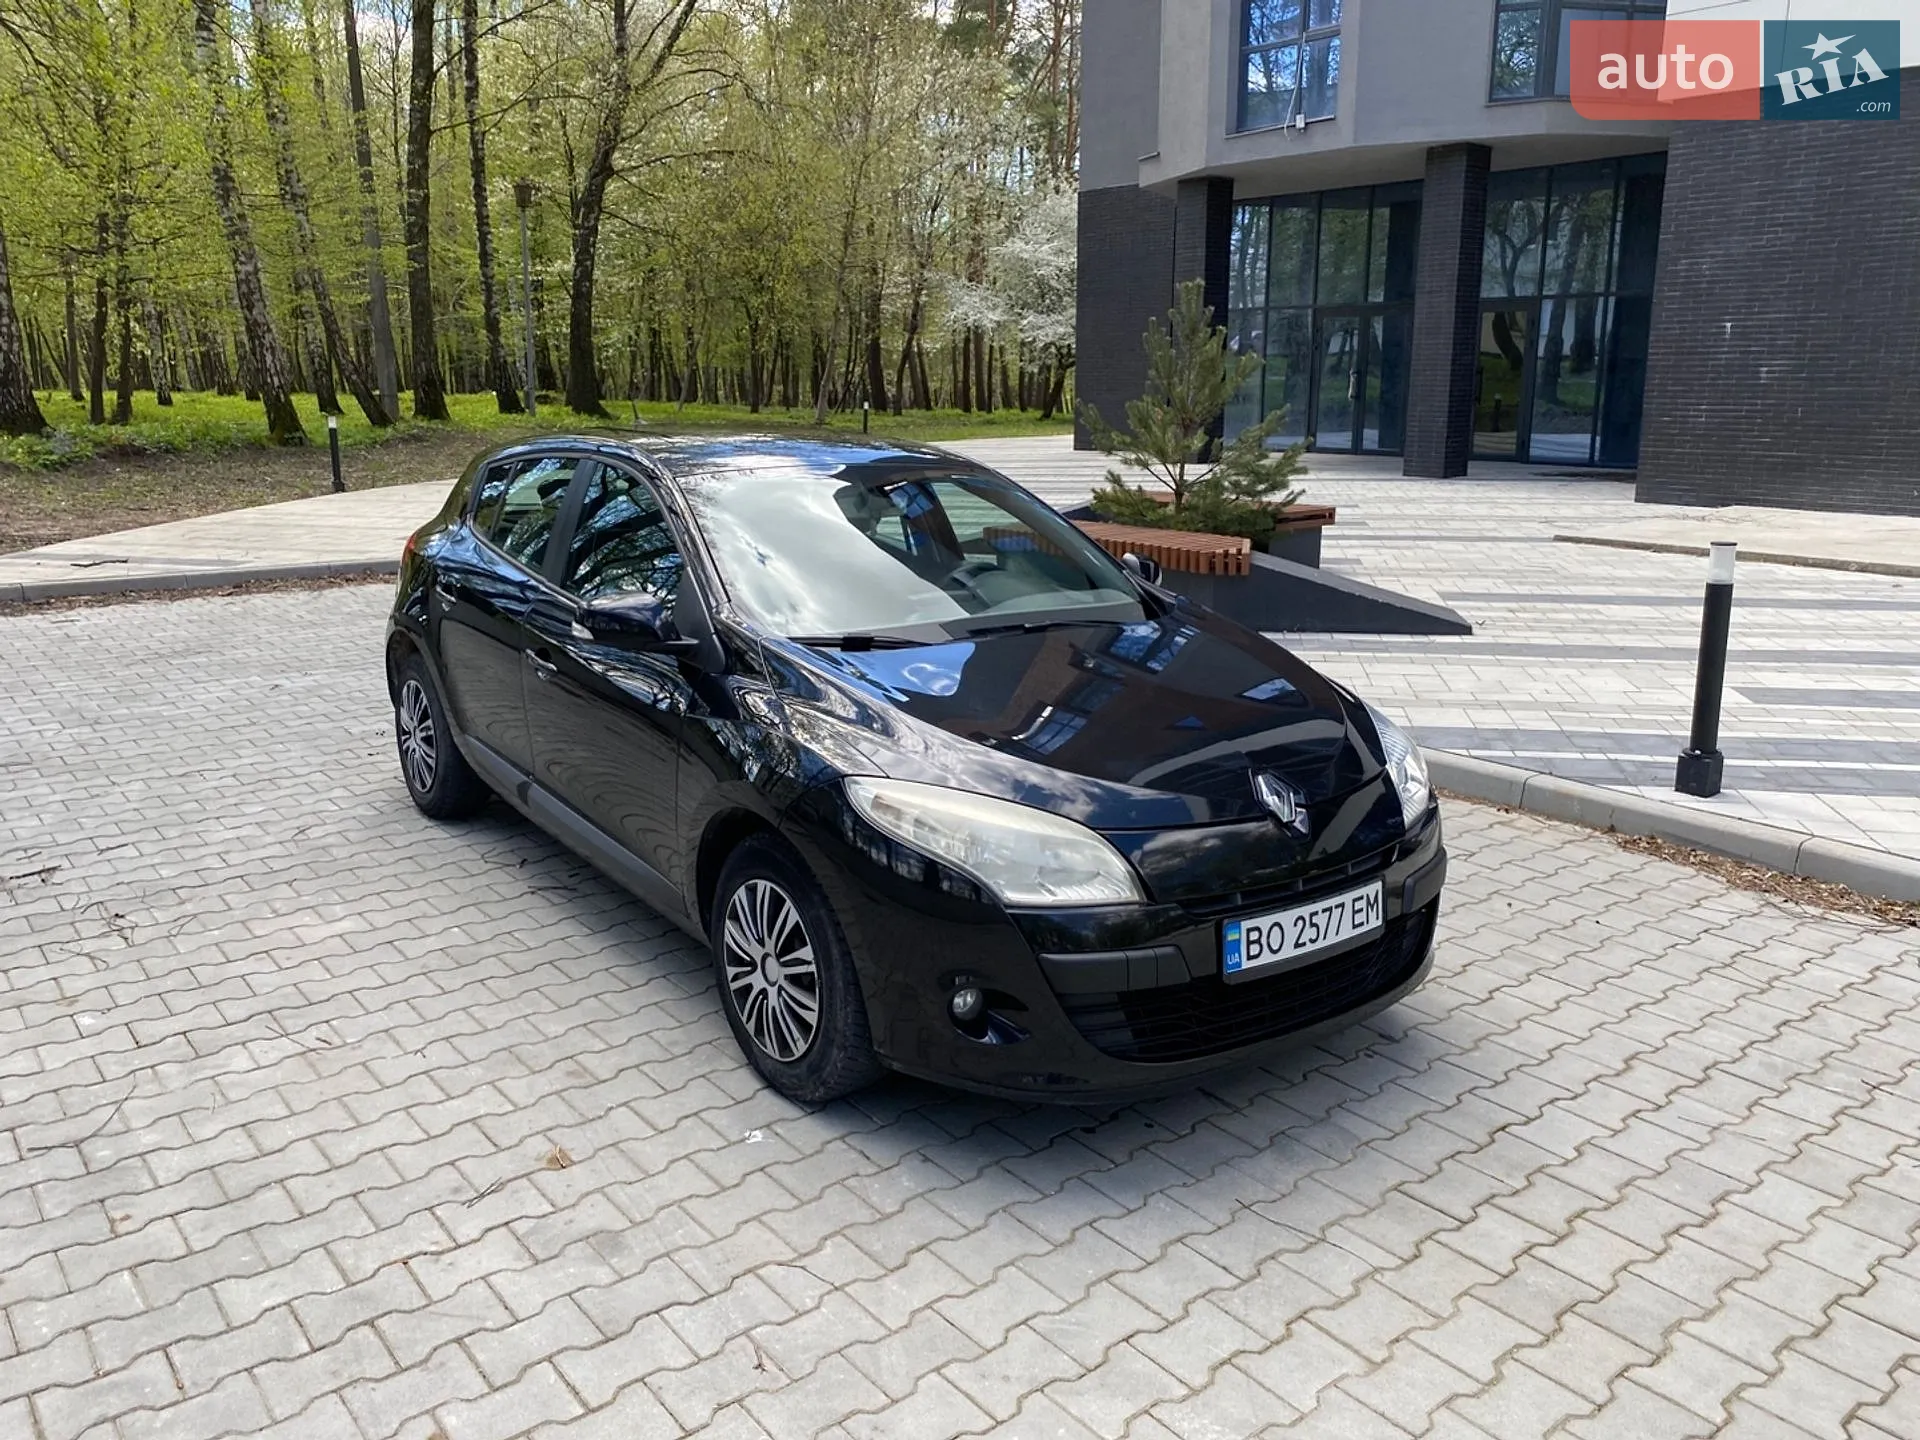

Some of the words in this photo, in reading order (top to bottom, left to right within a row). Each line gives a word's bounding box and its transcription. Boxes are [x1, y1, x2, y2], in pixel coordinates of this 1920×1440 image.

[1246, 921, 1285, 962] BO
[1293, 902, 1346, 950] 2577
[1352, 889, 1379, 930] EM
[1227, 953, 1240, 965] UA
